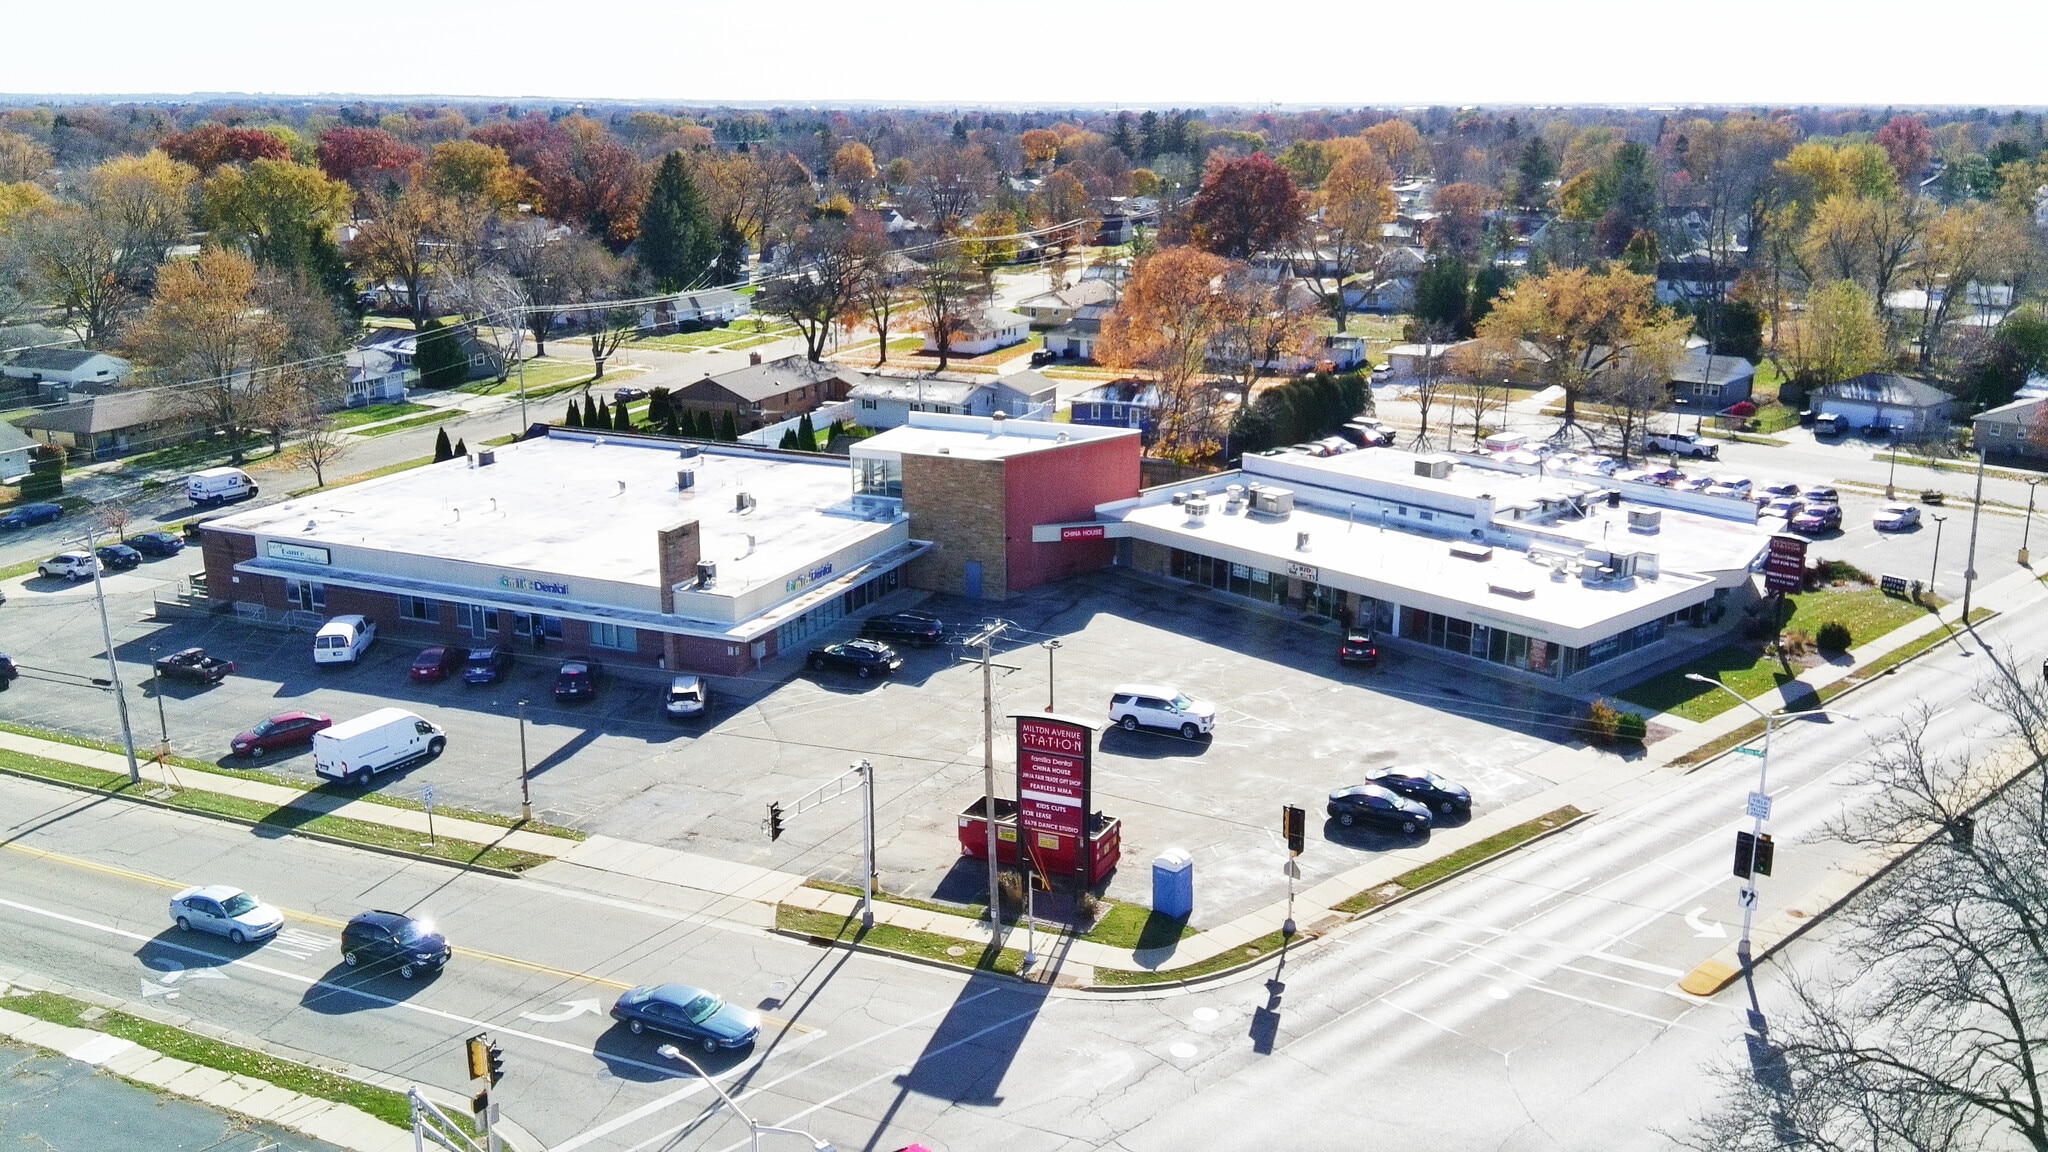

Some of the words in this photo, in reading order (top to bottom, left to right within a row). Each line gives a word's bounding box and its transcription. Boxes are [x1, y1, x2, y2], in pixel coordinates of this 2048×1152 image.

[811, 563, 832, 581] Dental
[534, 580, 568, 594] Dental
[1022, 724, 1050, 735] MILTON
[1052, 728, 1081, 740] AVENUE
[1031, 755, 1051, 764] familia
[1052, 758, 1072, 767] Dental
[1052, 768, 1071, 776] HOUSE
[1030, 783, 1056, 792] FEARLESS
[1038, 822, 1058, 831] DANCE
[1059, 825, 1079, 834] STUDIO
